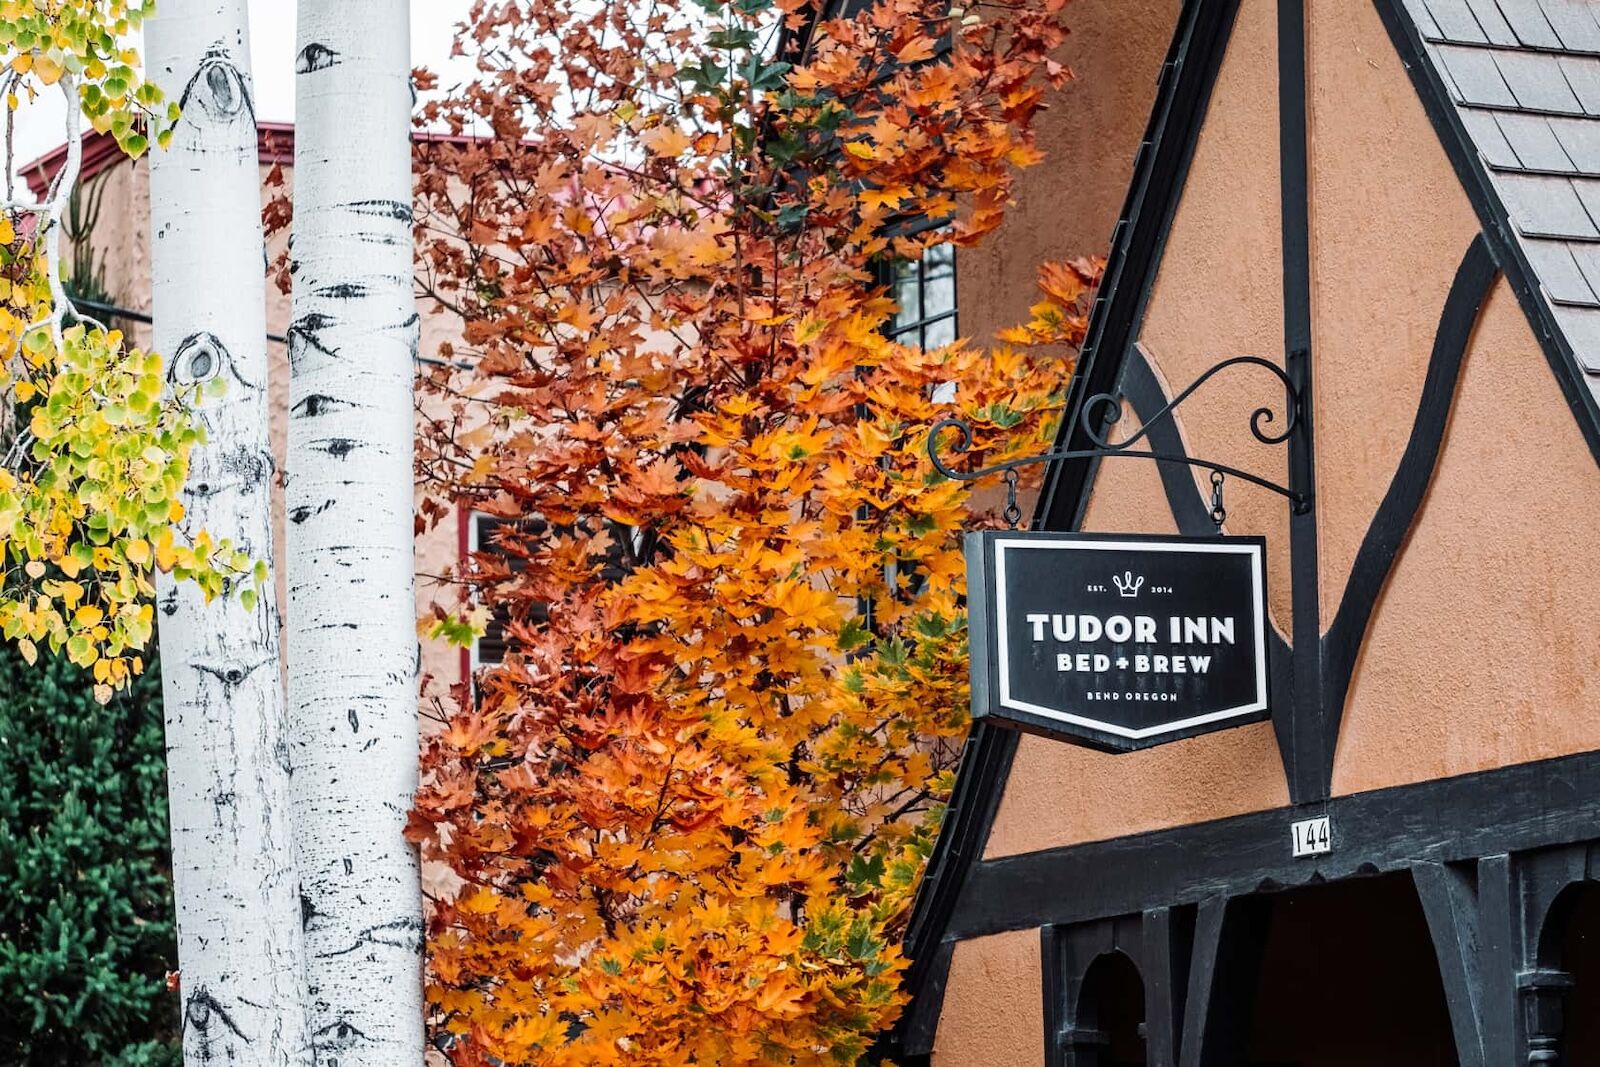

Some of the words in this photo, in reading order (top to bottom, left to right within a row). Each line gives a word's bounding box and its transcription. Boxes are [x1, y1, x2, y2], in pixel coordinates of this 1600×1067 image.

[1087, 584, 1107, 592] EST.
[1151, 586, 1173, 594] 2014
[1026, 613, 1158, 644] TUDOR
[1169, 616, 1235, 645] INN
[1056, 653, 1111, 673] BED
[1134, 655, 1212, 674] BREW
[1087, 692, 1120, 701] BEND
[1125, 692, 1178, 702] OREGON
[1296, 821, 1328, 853] 144
